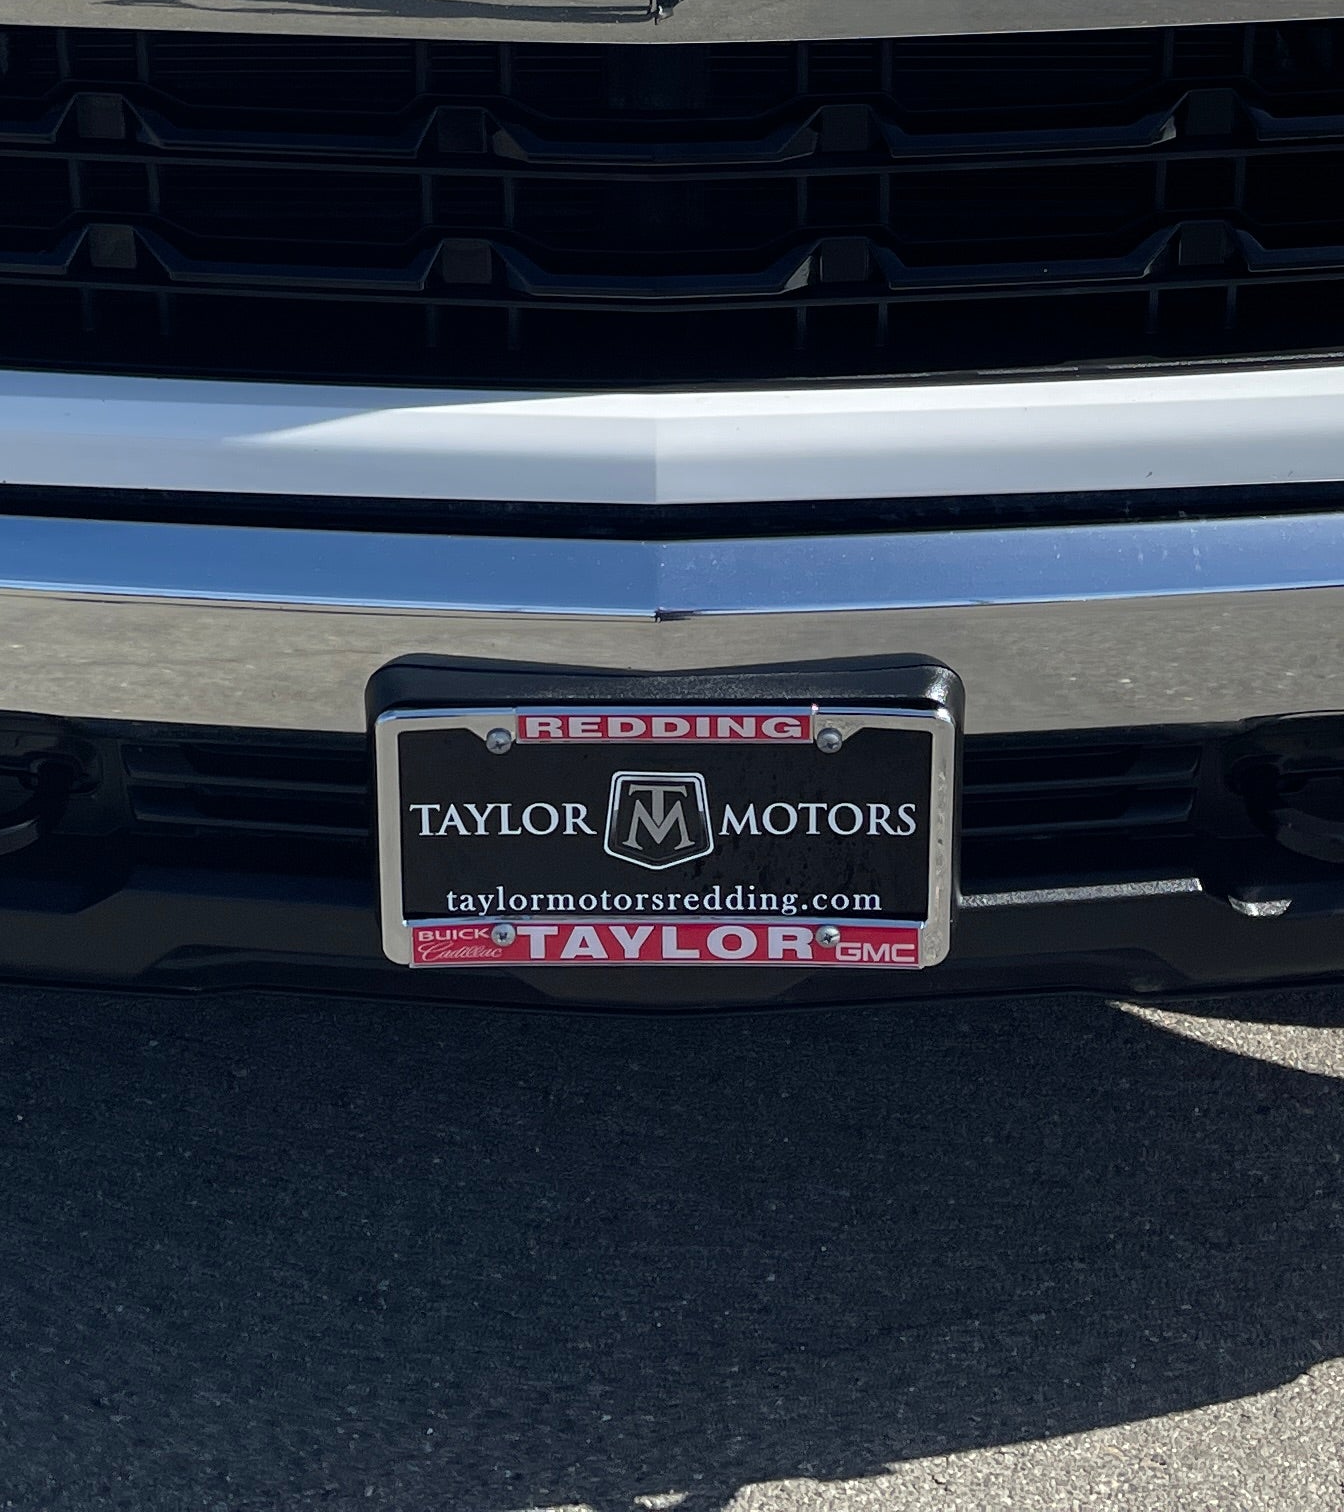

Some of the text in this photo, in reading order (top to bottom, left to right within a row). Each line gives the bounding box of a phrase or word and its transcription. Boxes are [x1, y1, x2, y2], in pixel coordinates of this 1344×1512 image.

[525, 717, 802, 738] REDDING
[409, 802, 597, 836] TAYLOR
[718, 802, 917, 836] MOTORS
[446, 885, 883, 916] taylormotorsredding.com
[418, 928, 490, 942] BUICK
[516, 925, 814, 960] TAYLOR
[417, 941, 503, 963] Cadillac
[835, 942, 915, 963] GMC
